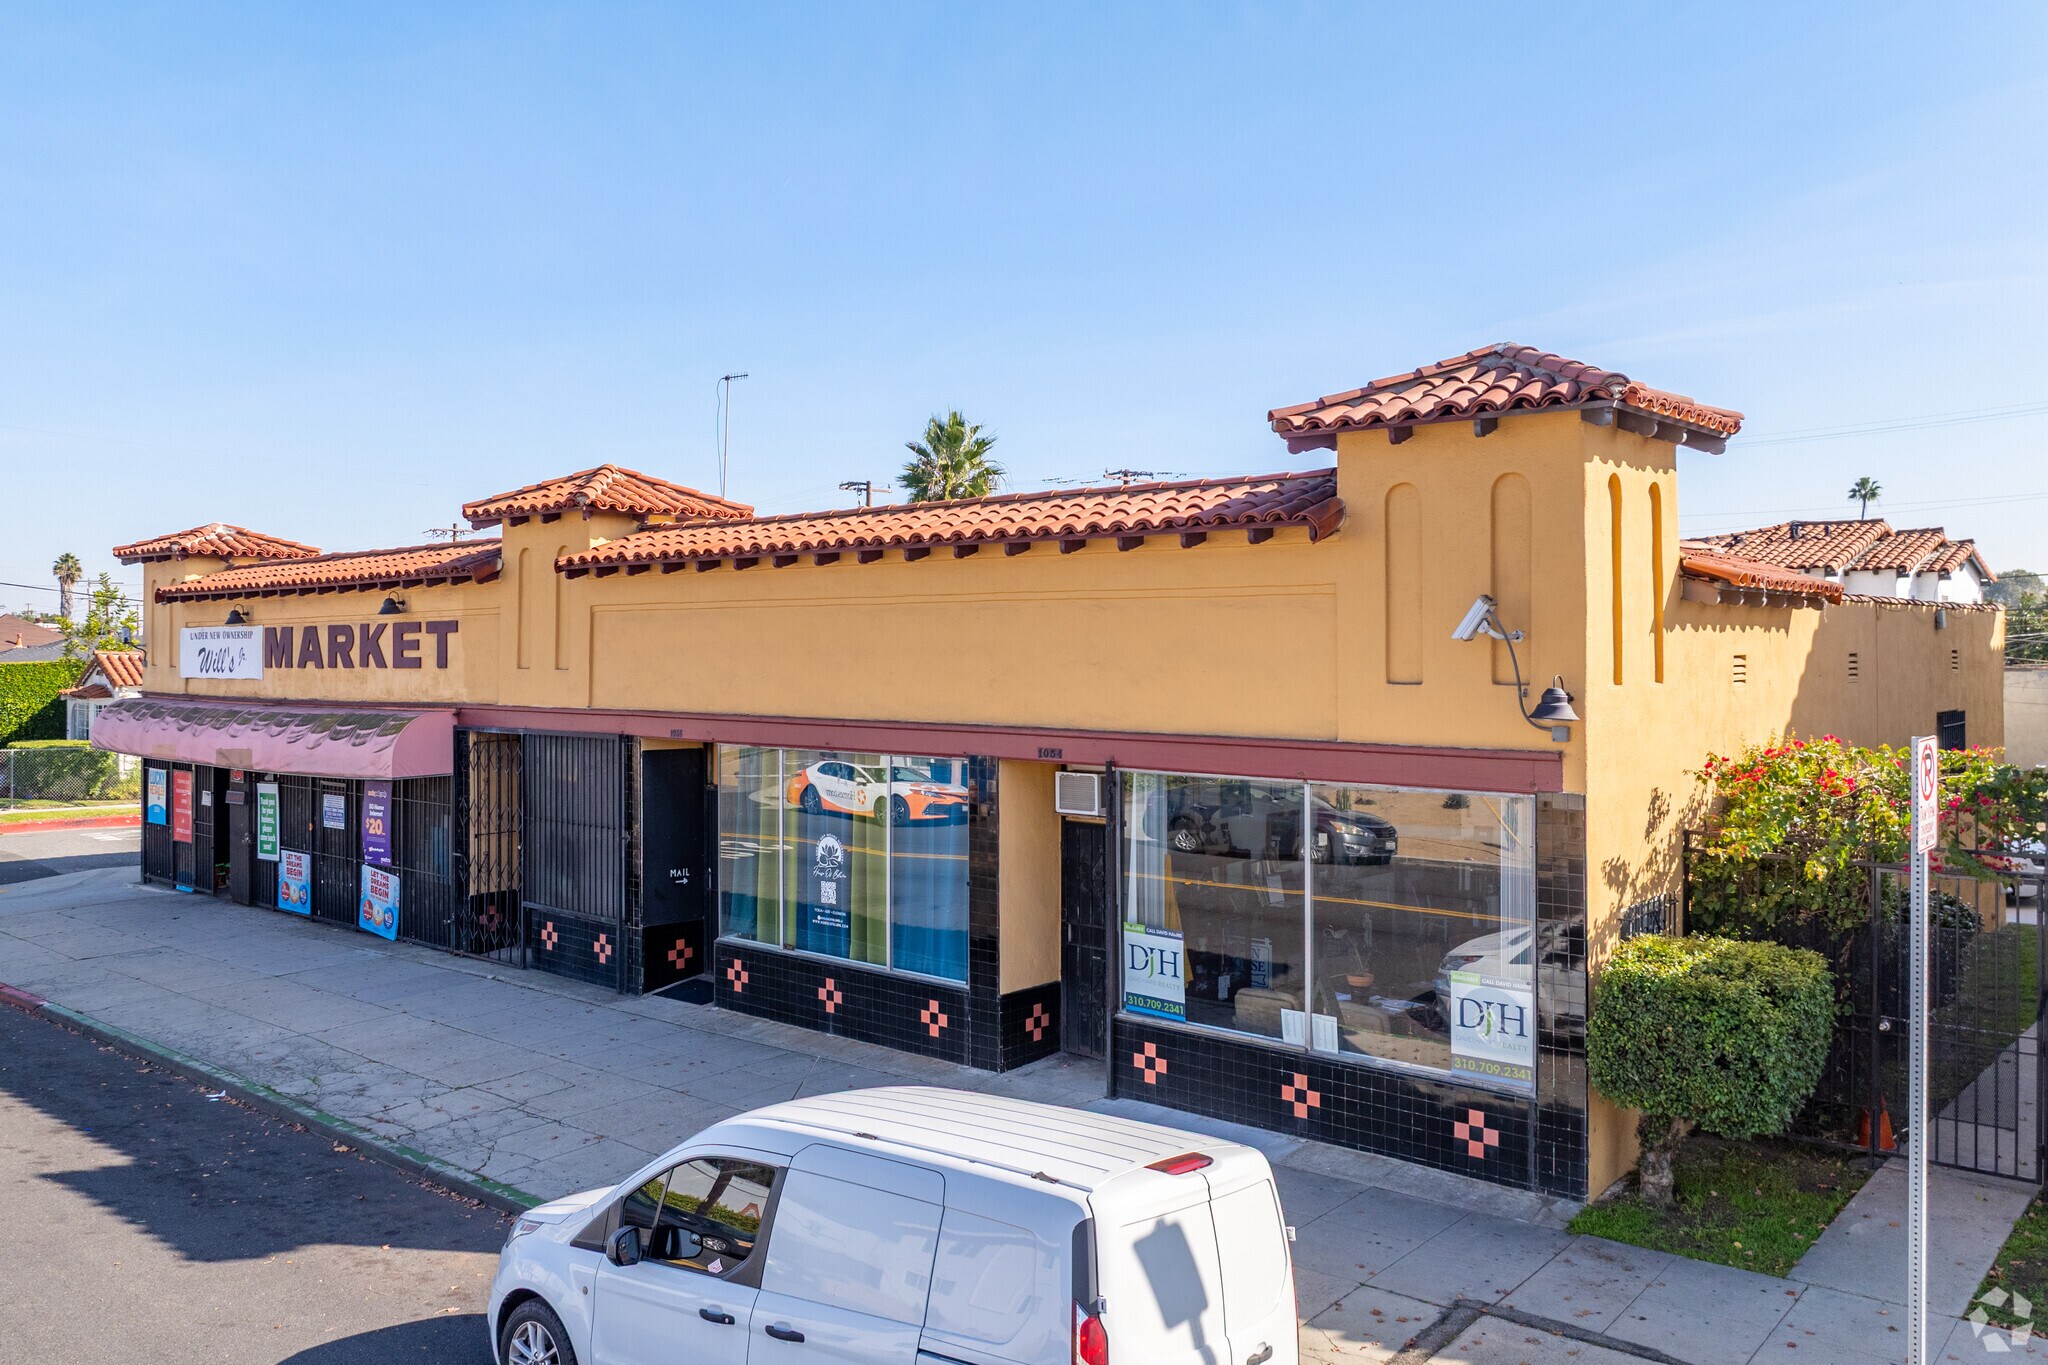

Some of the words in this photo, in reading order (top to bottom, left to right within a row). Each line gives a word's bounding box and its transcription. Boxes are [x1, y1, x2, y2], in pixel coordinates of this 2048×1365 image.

[190, 631, 208, 640] UNDER
[209, 631, 220, 640] NEW
[222, 630, 254, 640] OWNERSHIP
[264, 620, 458, 669] MARKET
[198, 646, 235, 674] Will's
[286, 860, 302, 869] DREAMS
[294, 854, 302, 862] THE
[286, 867, 302, 877] BEGIN
[371, 869, 379, 879] LET
[380, 873, 389, 882] THE
[670, 867, 690, 878] MAIL
[370, 877, 389, 889] DREAMS
[370, 885, 389, 899] BEGIN
[1128, 943, 1180, 979] DJH
[1128, 995, 1184, 1015] 310.709.2341
[1454, 1057, 1532, 1081] 310.709.2341
